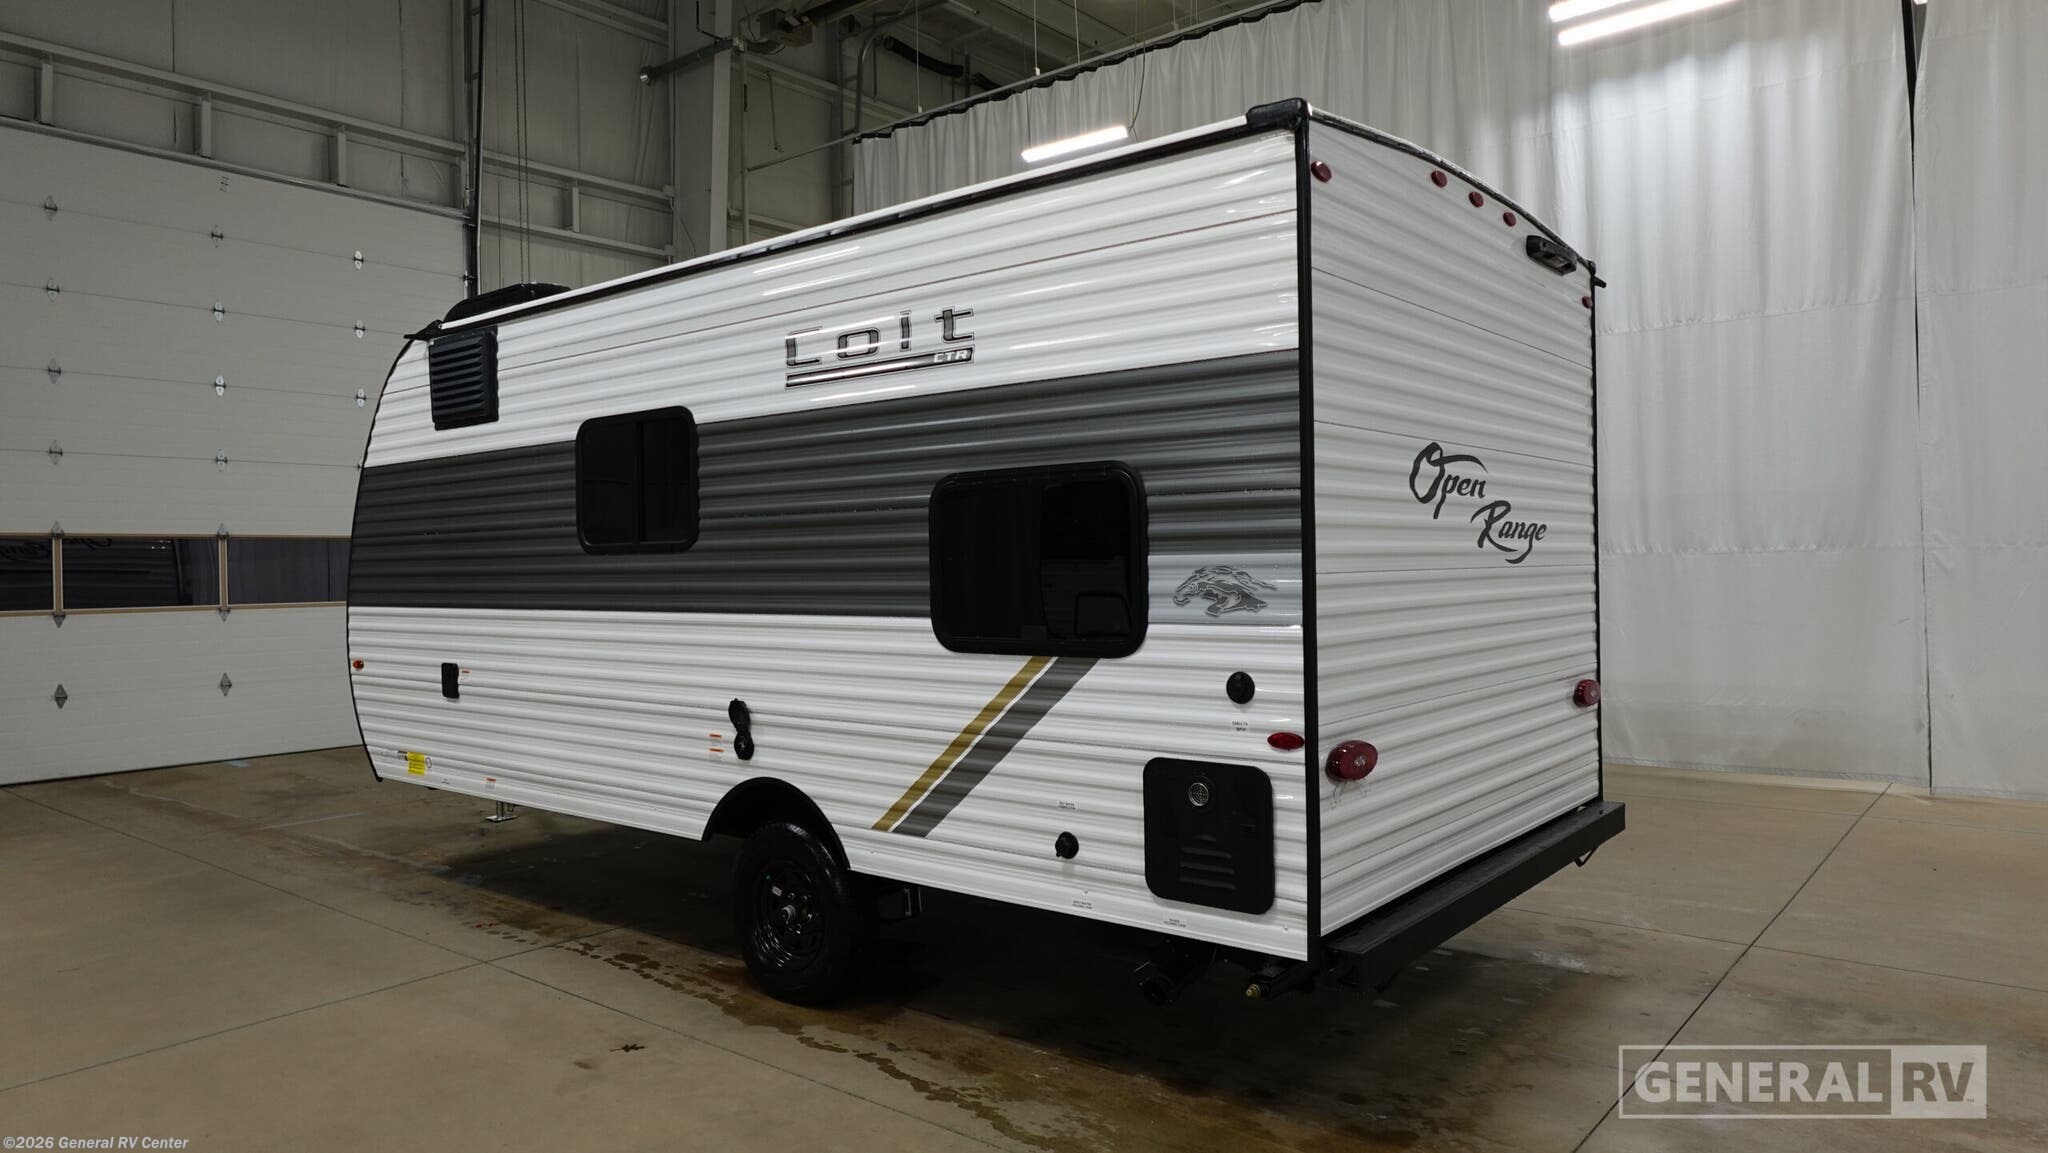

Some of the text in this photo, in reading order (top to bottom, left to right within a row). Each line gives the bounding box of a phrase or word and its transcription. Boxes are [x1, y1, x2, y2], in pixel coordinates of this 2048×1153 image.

[785, 306, 974, 368] Colt
[933, 350, 968, 363] CTR
[1409, 441, 1488, 520] Open
[1470, 499, 1547, 564] Range
